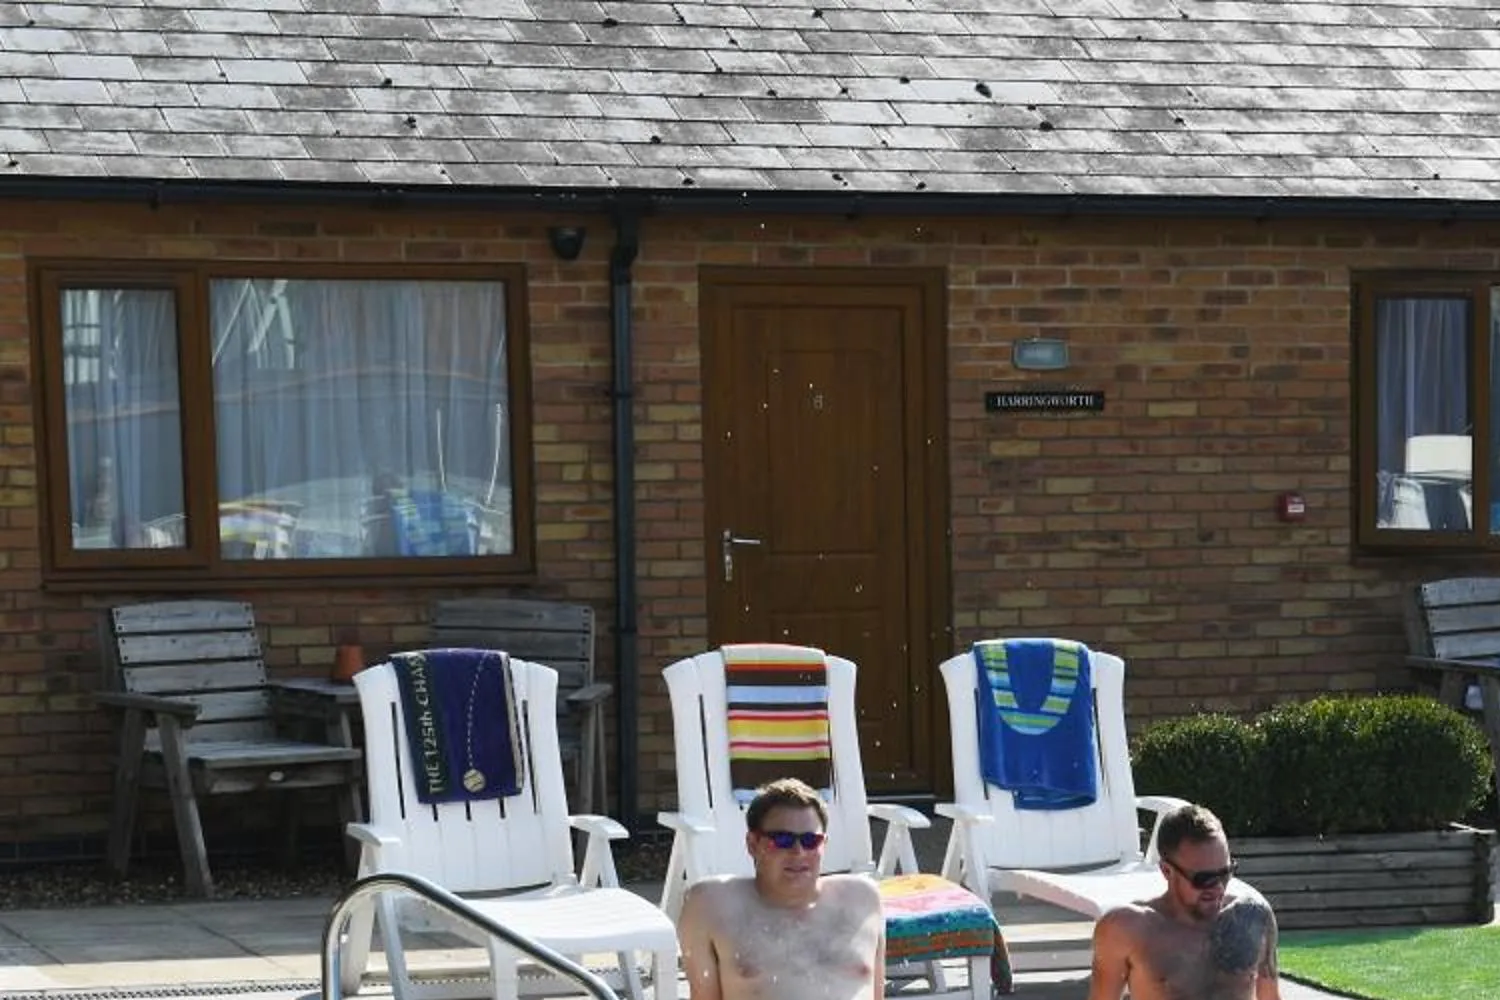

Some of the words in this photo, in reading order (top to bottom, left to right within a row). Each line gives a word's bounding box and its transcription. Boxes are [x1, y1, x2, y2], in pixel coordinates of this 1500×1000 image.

[996, 394, 1094, 407] HARRINGWORTH
[417, 711, 439, 759] 125th
[424, 761, 446, 795] THE
